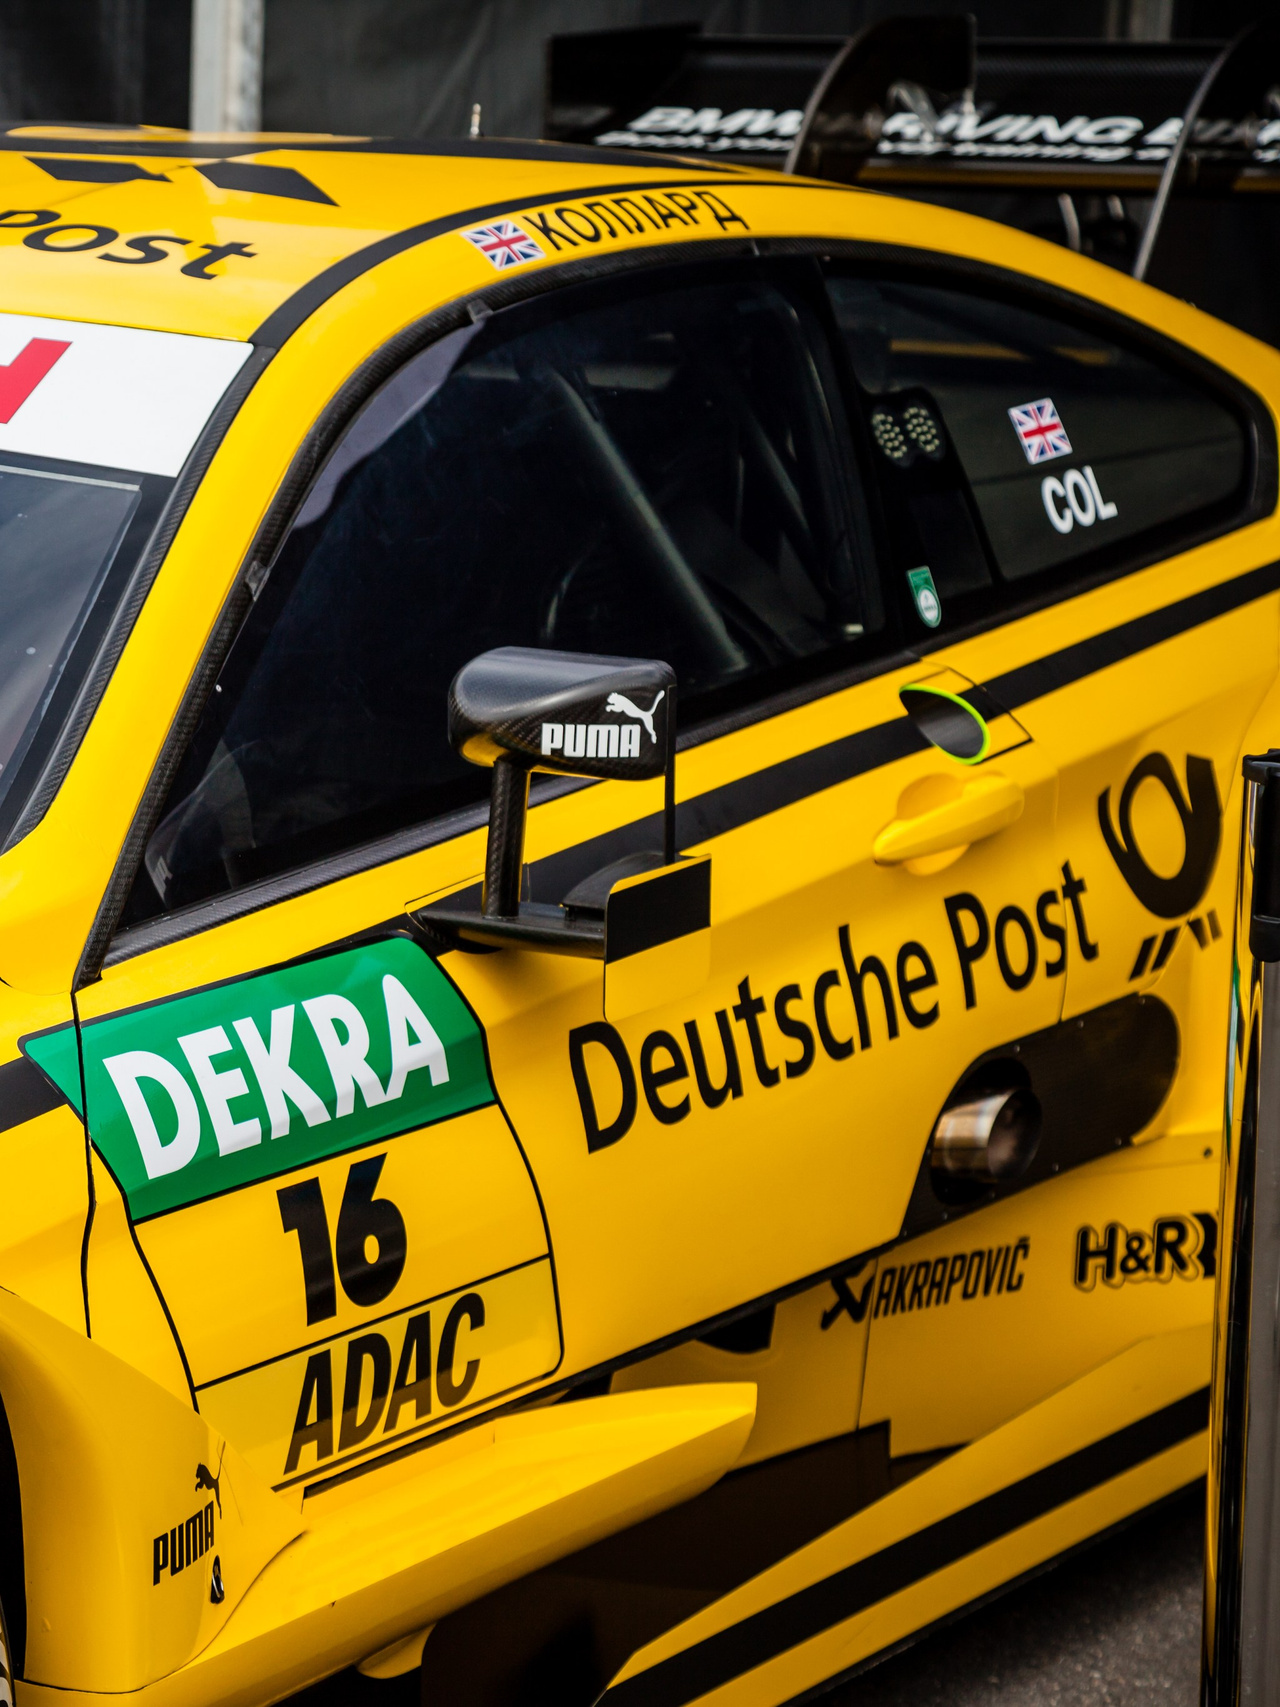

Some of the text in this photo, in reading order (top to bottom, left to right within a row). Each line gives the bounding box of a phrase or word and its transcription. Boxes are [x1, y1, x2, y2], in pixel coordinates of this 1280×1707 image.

[521, 190, 751, 251] КОЛЛАРД
[1041, 465, 1118, 535] COL
[541, 723, 641, 758] PUMA
[568, 858, 1099, 1154] Deutsche Post
[102, 973, 450, 1180] DEKRA
[276, 1152, 407, 1327] 16
[1075, 1215, 1200, 1293] H&R
[283, 1293, 486, 1475] ADAC
[153, 1500, 214, 1587] PUMA
